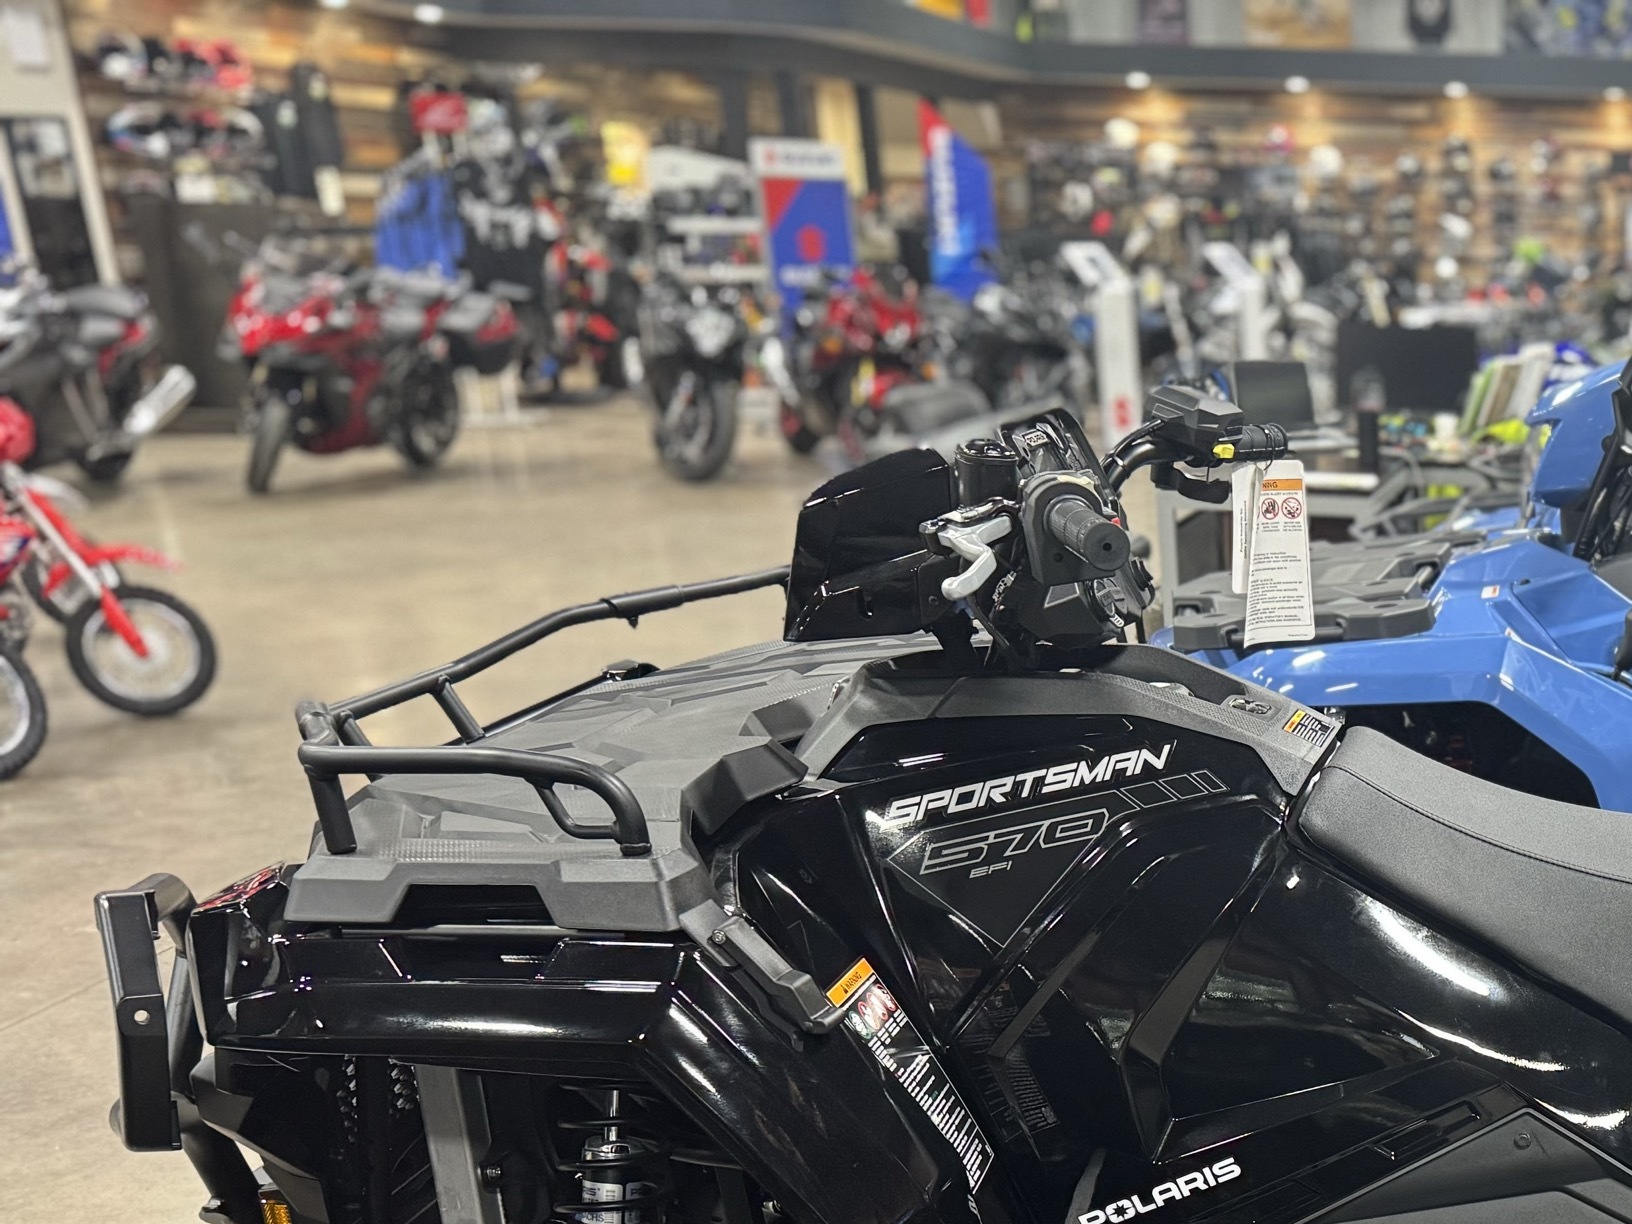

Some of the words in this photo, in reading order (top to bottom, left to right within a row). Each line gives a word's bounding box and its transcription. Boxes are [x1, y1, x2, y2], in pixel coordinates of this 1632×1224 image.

[884, 744, 1172, 826] SPORTSMAN
[920, 808, 1109, 875] 570
[969, 861, 1013, 879] EFI
